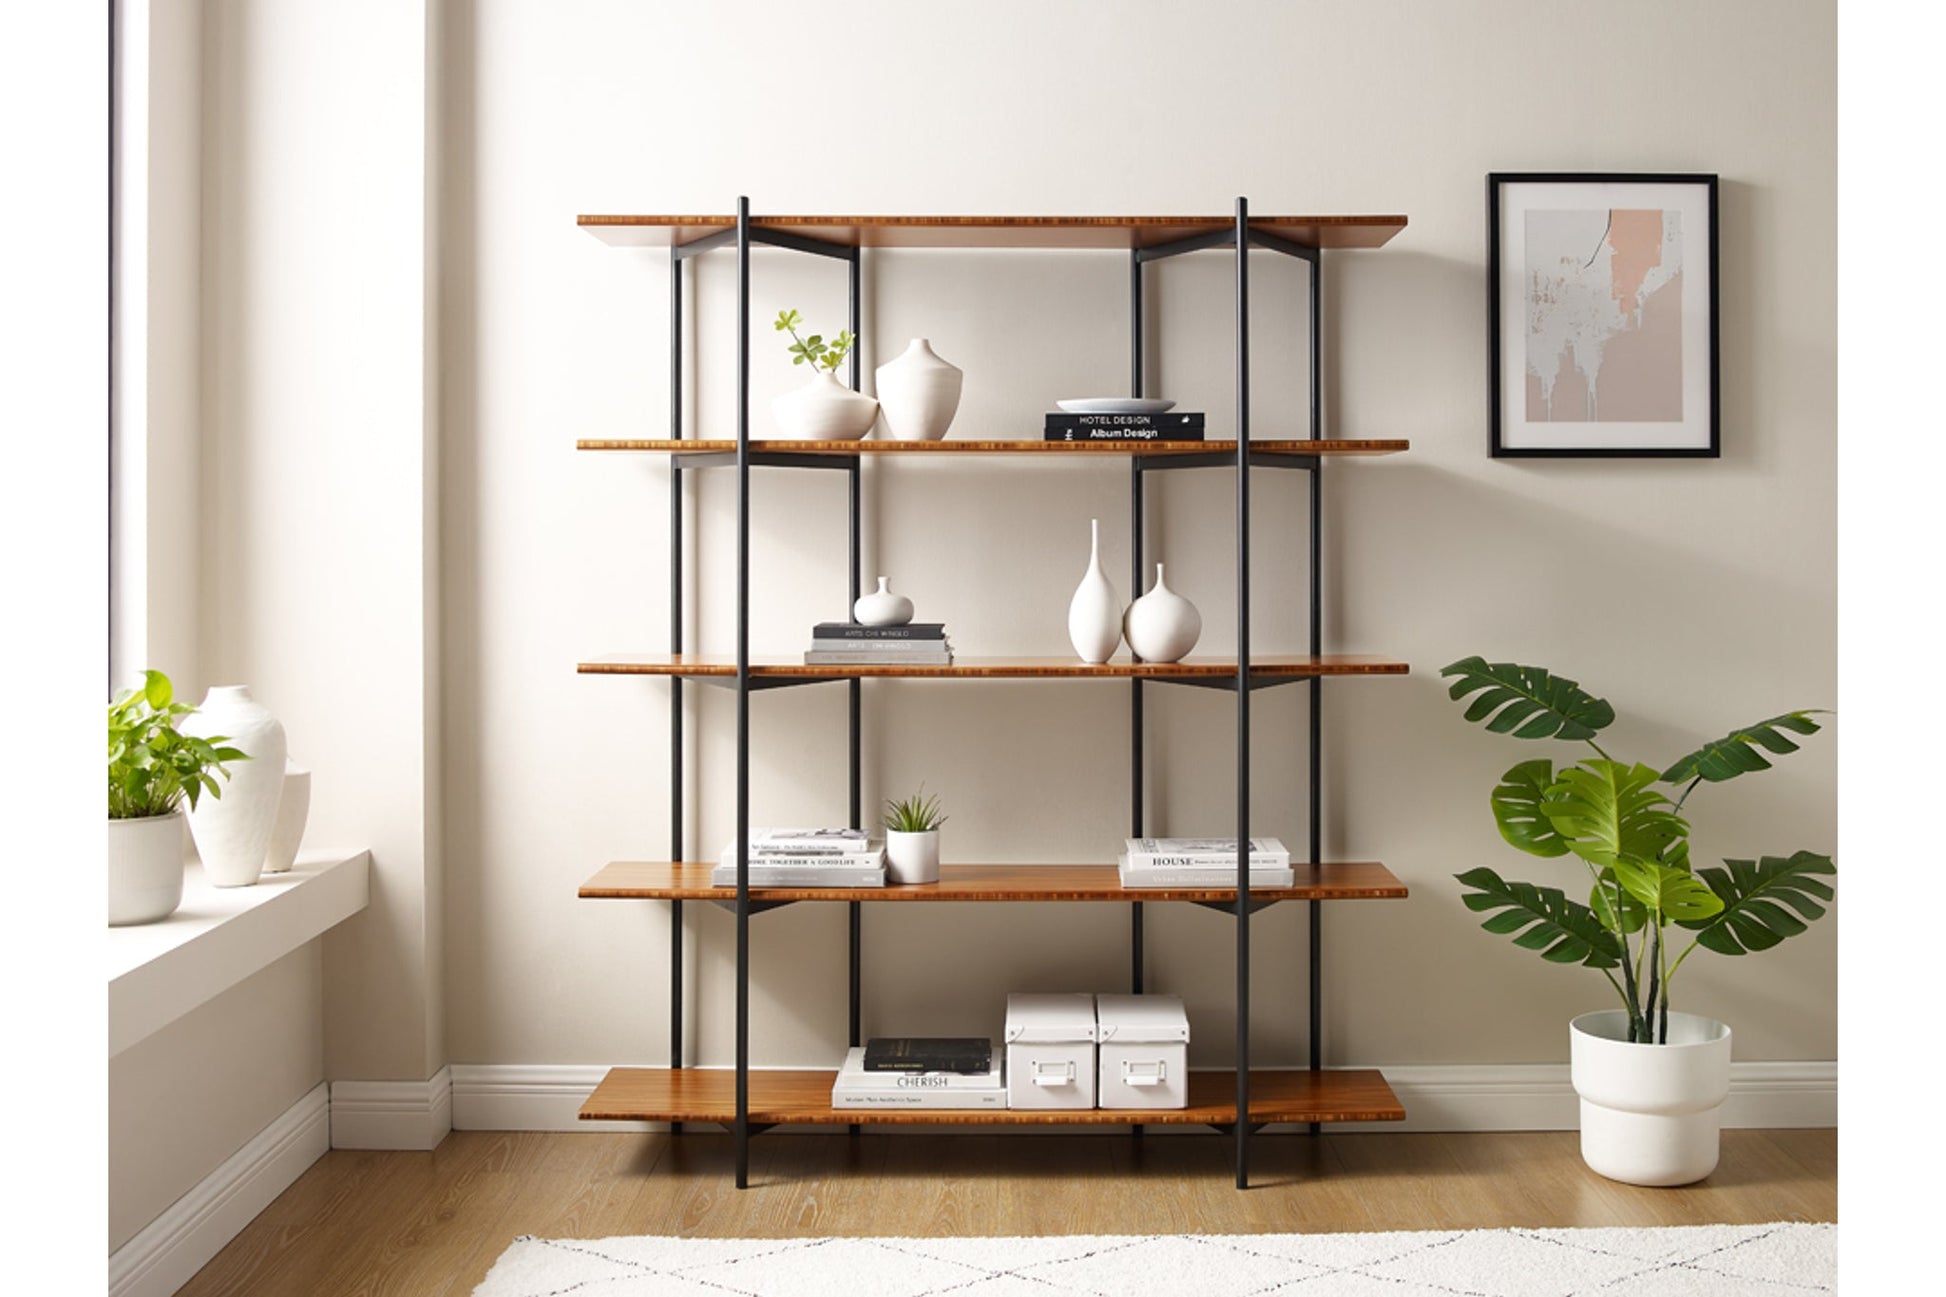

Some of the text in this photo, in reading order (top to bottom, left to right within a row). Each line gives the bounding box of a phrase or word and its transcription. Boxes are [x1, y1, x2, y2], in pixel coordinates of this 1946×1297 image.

[1079, 416, 1151, 425] HOTEL DESIGN
[1090, 428, 1158, 439] Album Design
[1152, 857, 1193, 866] HOUSE
[897, 1077, 948, 1088] CHERISH
